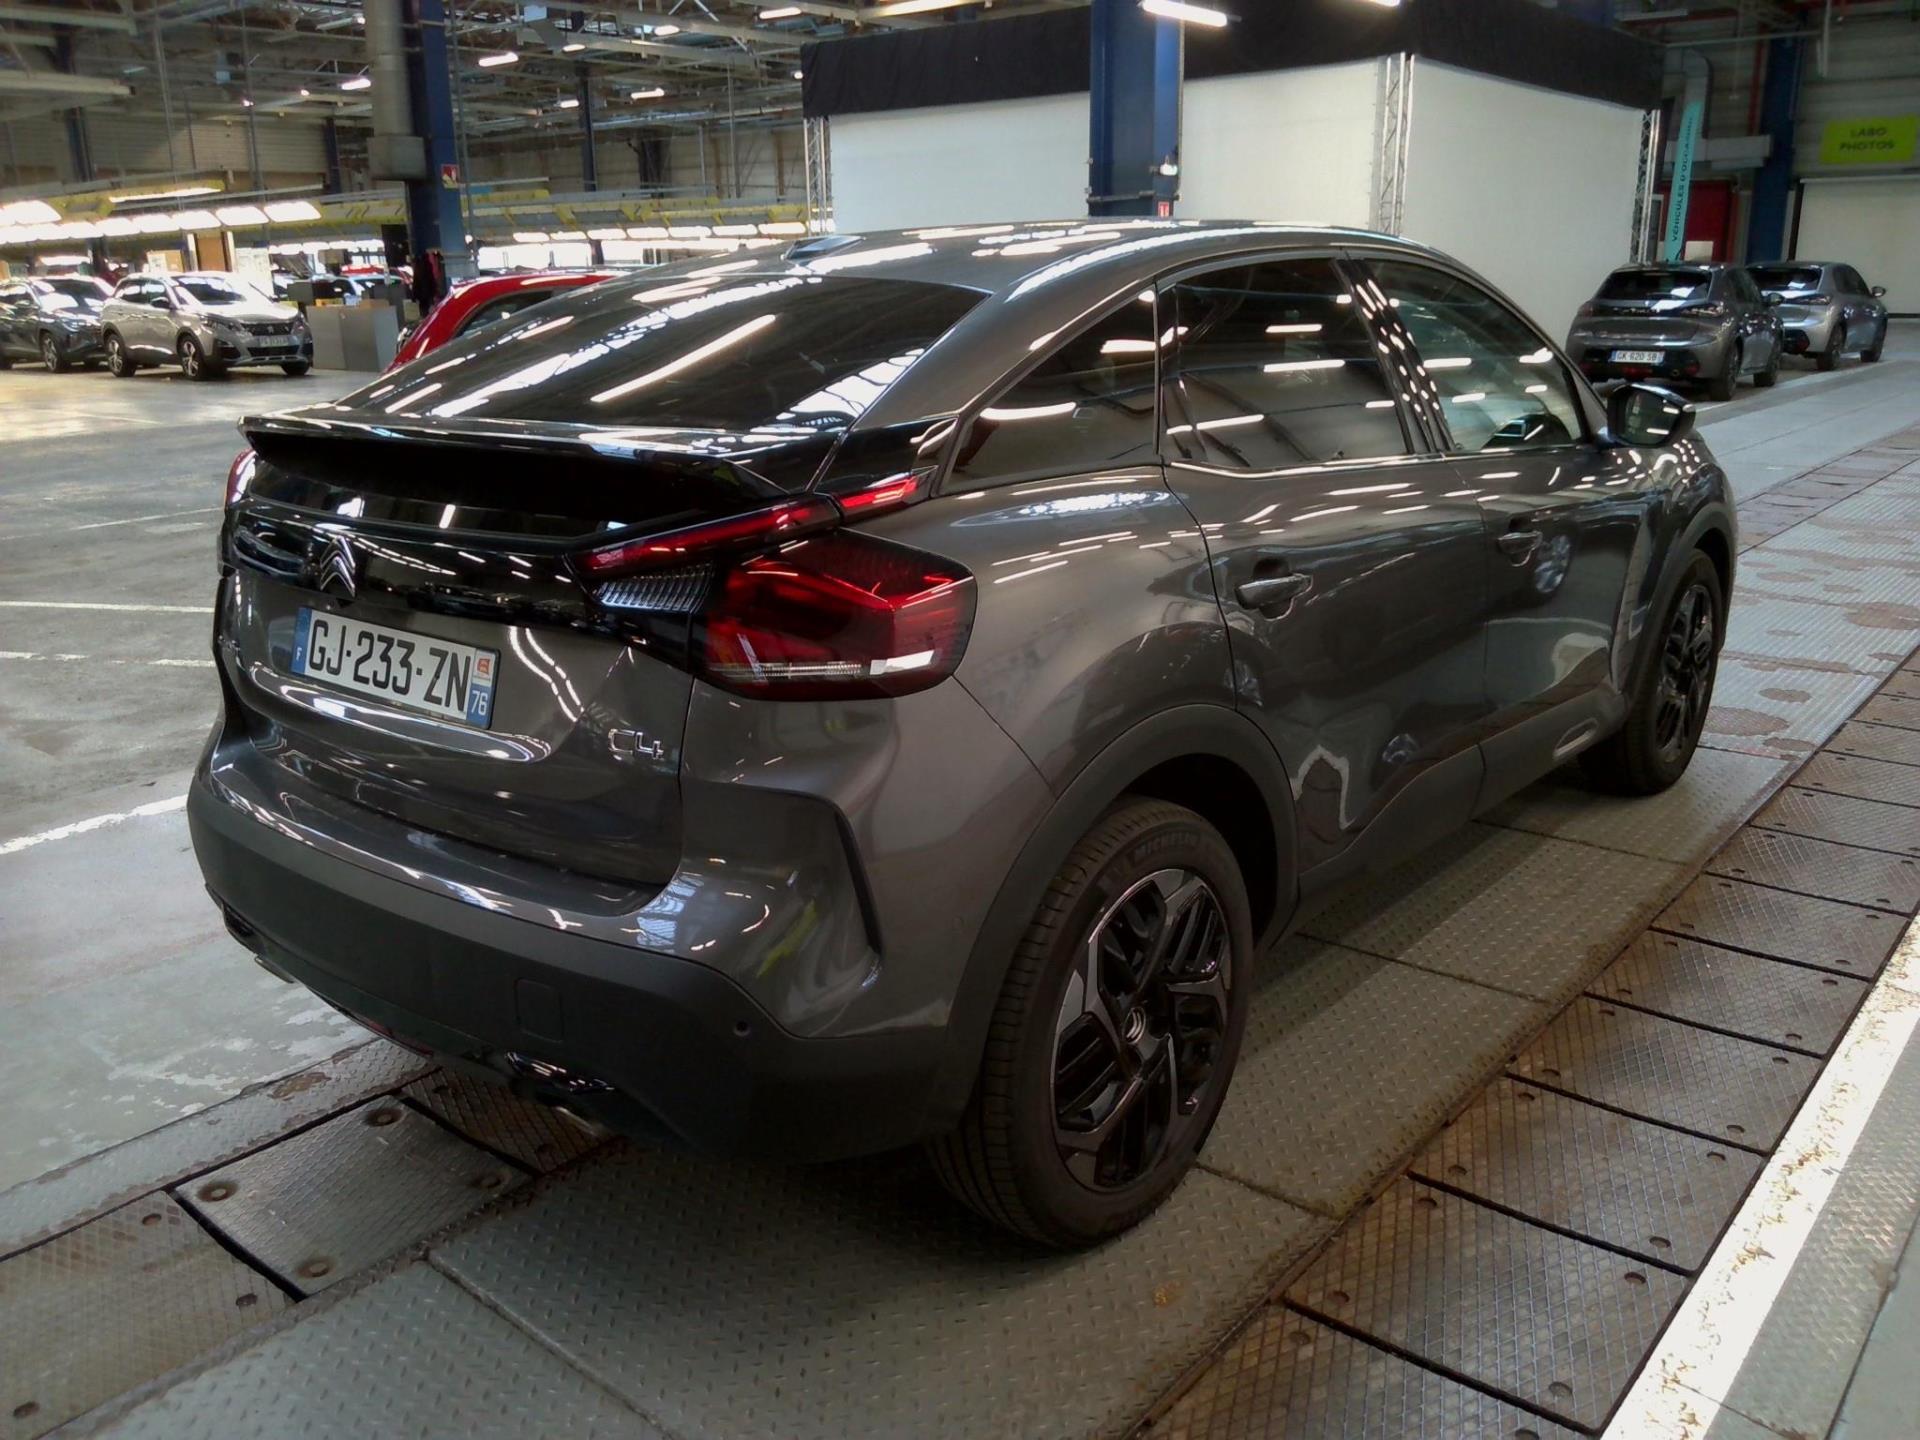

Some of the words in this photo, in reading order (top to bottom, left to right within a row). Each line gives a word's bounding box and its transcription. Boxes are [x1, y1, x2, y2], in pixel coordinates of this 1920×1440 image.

[1839, 139, 1896, 152] PHOTOS
[309, 618, 472, 713] GJ-233-ZN
[471, 689, 489, 716] 76
[607, 730, 665, 760] C4
